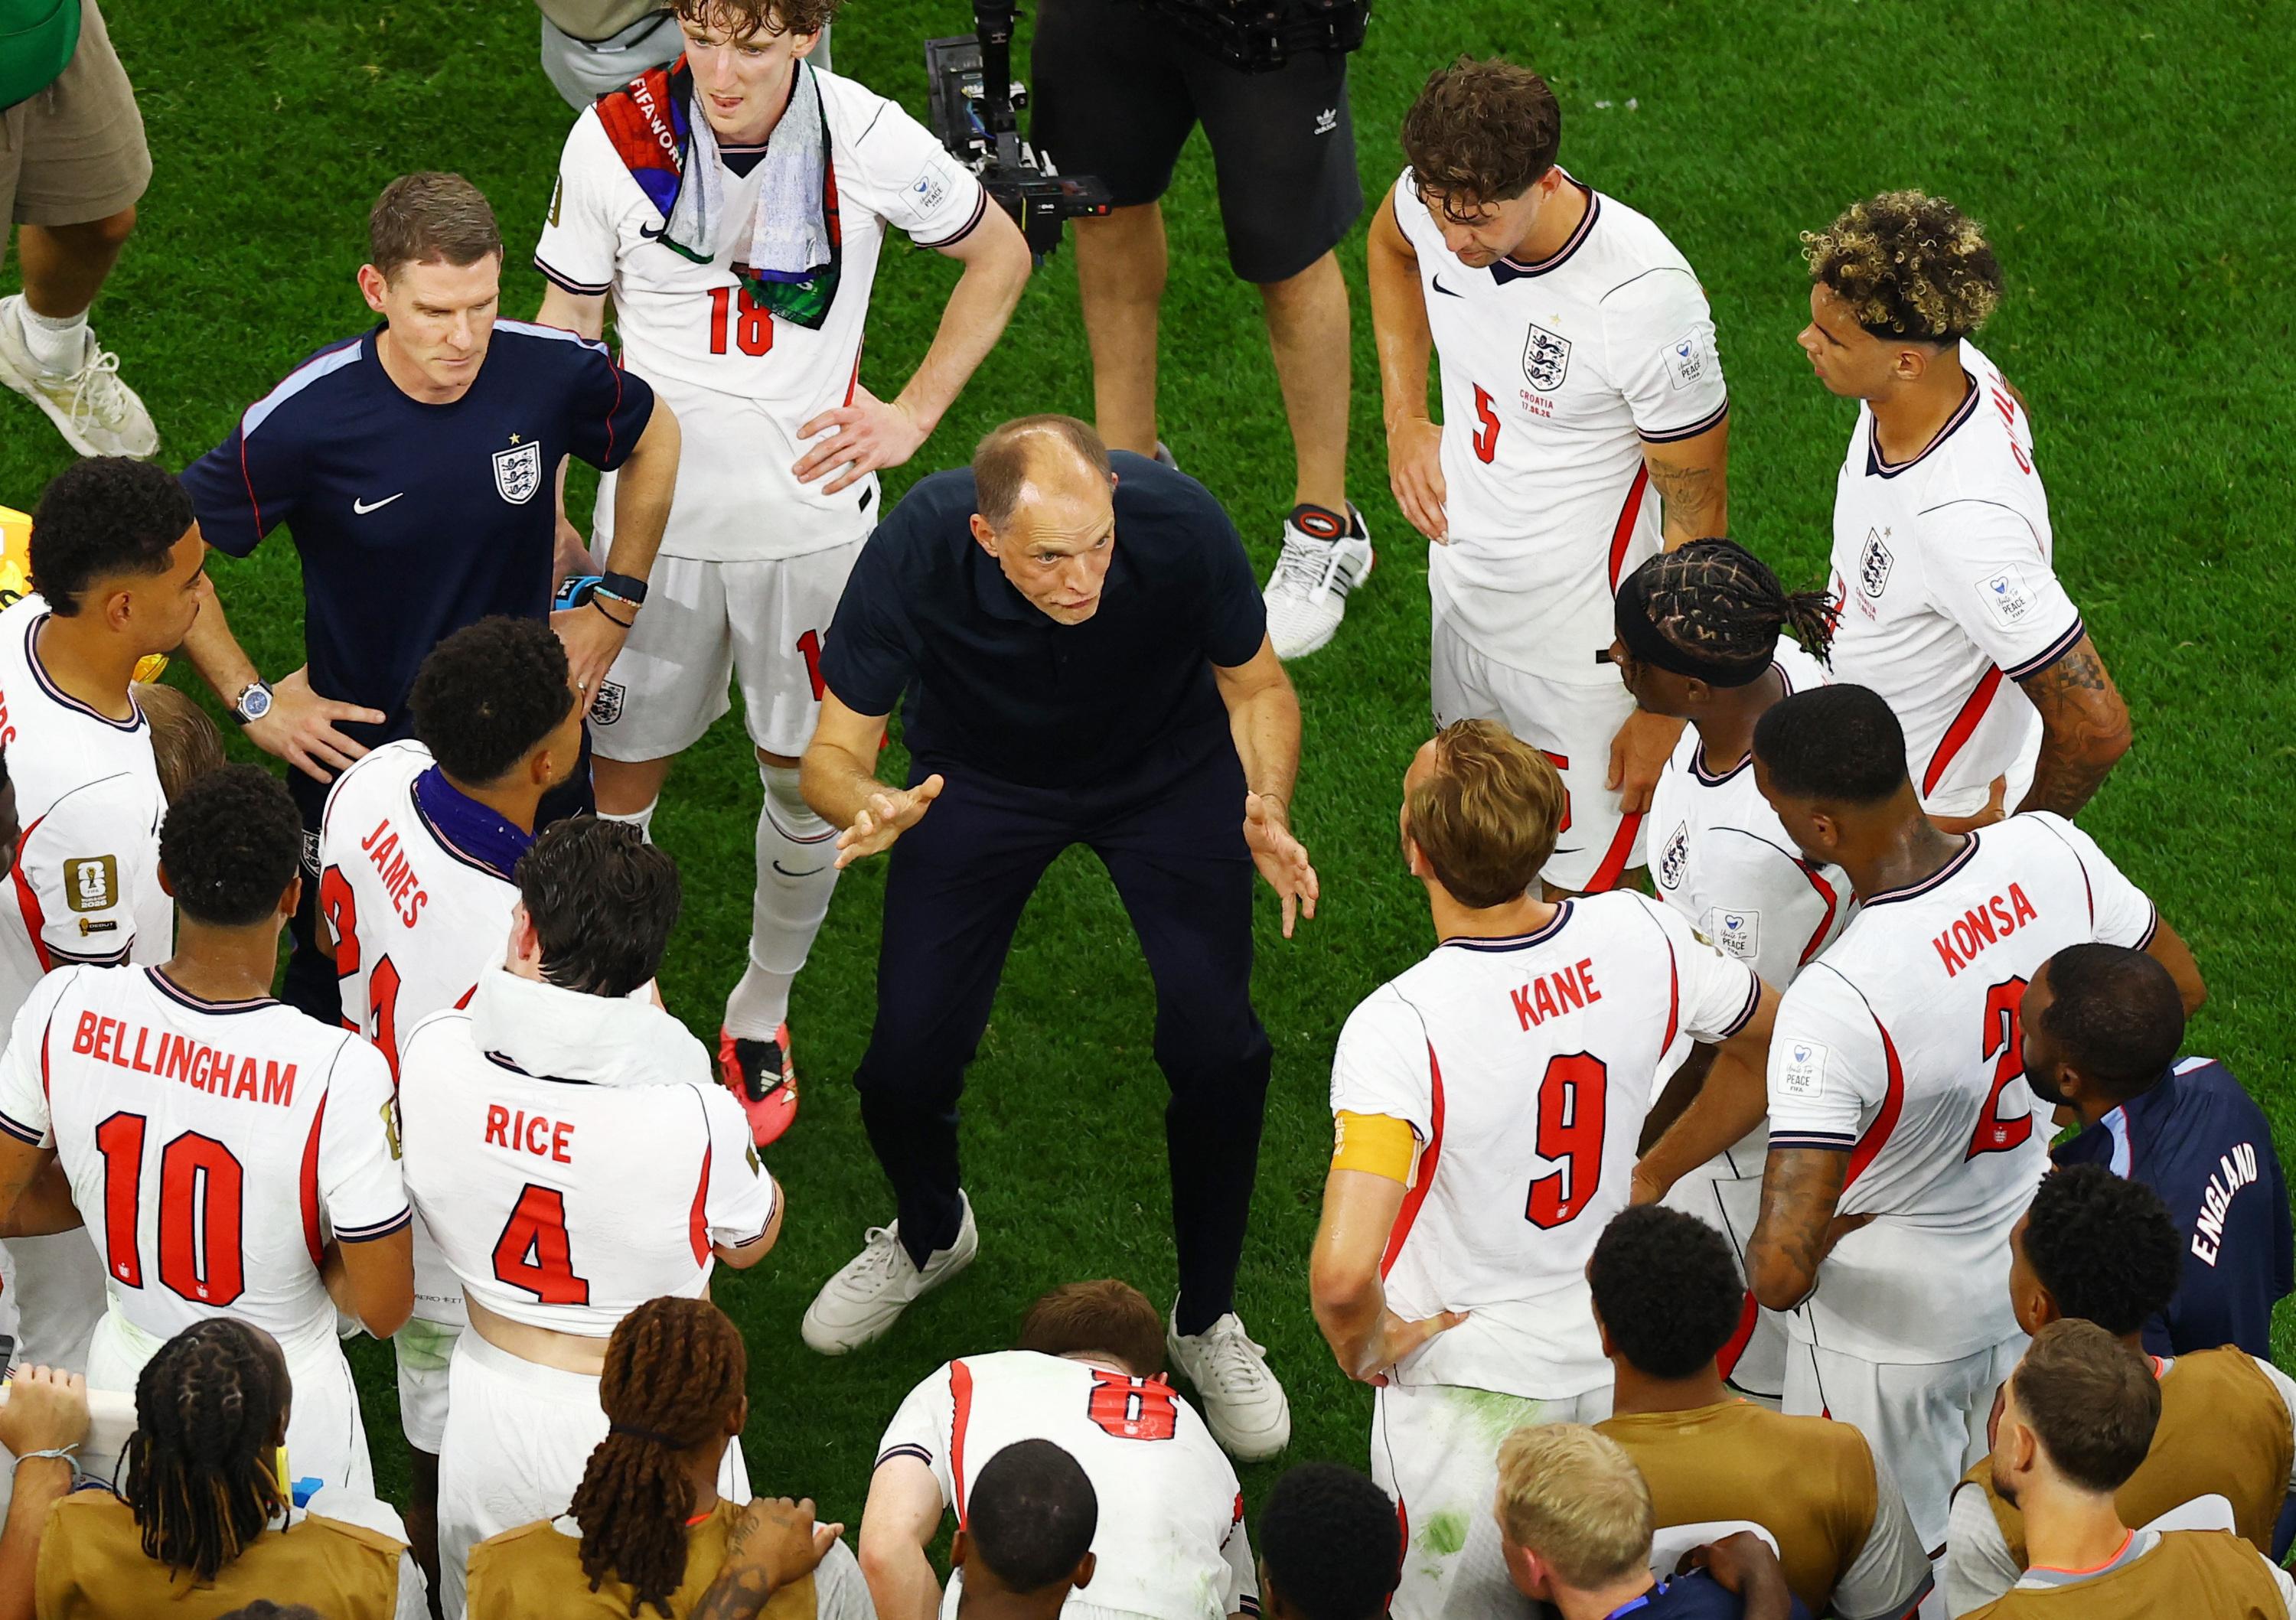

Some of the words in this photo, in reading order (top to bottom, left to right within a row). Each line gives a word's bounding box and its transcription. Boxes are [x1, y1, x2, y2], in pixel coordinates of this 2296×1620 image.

[630, 77, 655, 119] FIFA
[708, 286, 775, 357] 18
[1519, 389, 1554, 409] CROATIA
[1681, 359, 1701, 378] PEACE
[1472, 383, 1502, 464] 5
[2002, 596, 2027, 615] PEACE
[81, 899, 107, 908] 2026
[361, 819, 429, 929] JAMES
[1722, 937, 1746, 950] PEACE
[1932, 882, 2038, 978] KONSA
[1510, 957, 1603, 1032] KANE
[73, 1010, 298, 1107] BELLINGHAM
[1787, 1073, 1811, 1087] PEACE
[1964, 974, 2033, 1164] 2
[484, 1104, 576, 1164] RICE
[1525, 1050, 1607, 1230] 9
[95, 1110, 245, 1308] 10
[2190, 1141, 2258, 1267] ENGLAND
[491, 1182, 590, 1306] 4
